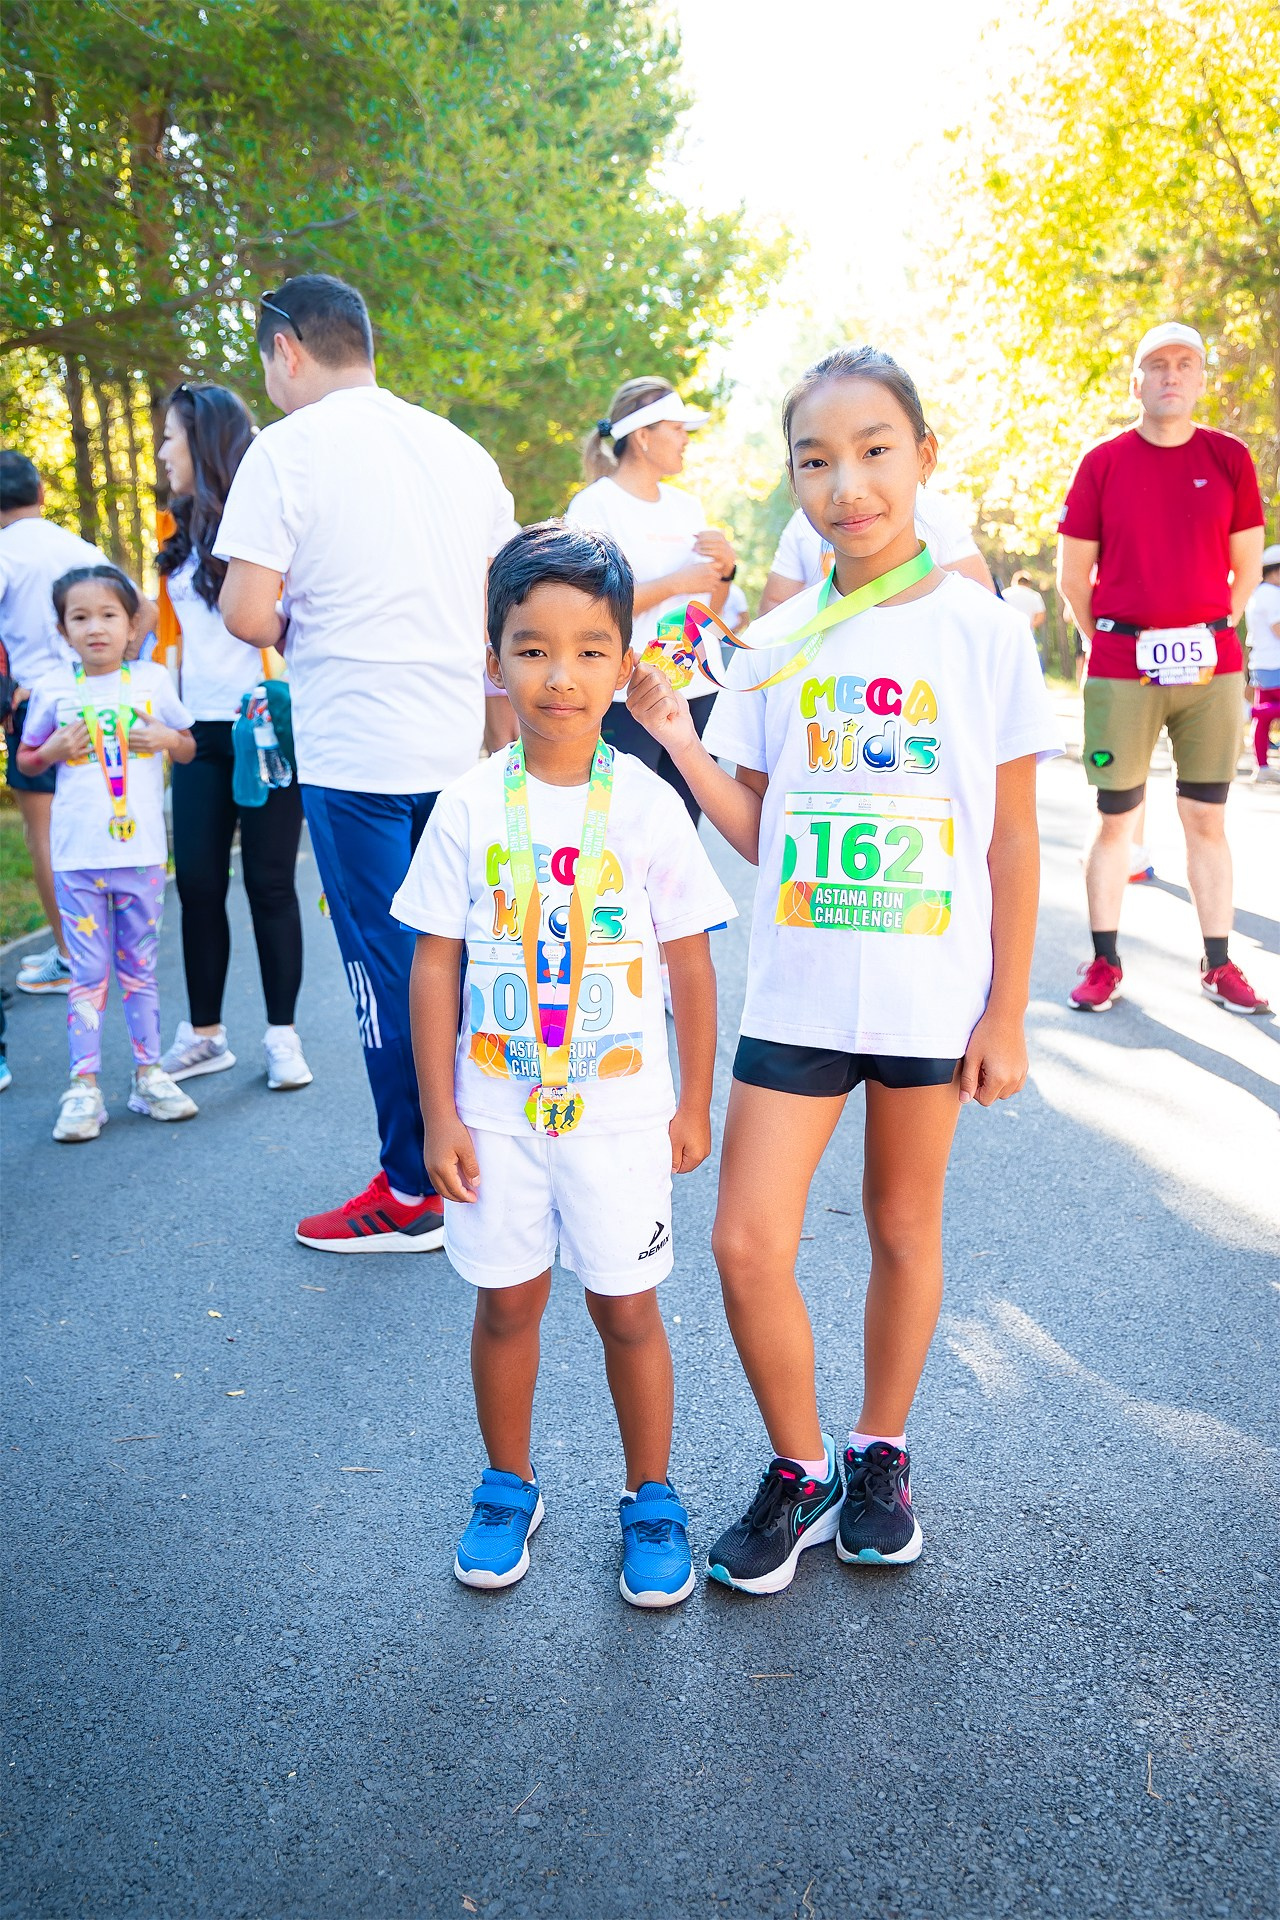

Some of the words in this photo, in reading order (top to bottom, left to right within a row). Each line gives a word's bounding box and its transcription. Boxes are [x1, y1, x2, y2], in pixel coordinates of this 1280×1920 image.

[1153, 642, 1202, 664] 005
[799, 675, 940, 726] MEGA
[810, 821, 923, 884] 162
[814, 887, 868, 907] ASTANA
[872, 890, 904, 909] RUN
[814, 906, 903, 929] CHALLENGE
[493, 972, 614, 1032] 09
[509, 1040, 539, 1059] ASTA
[511, 1059, 597, 1079] CHANGE
